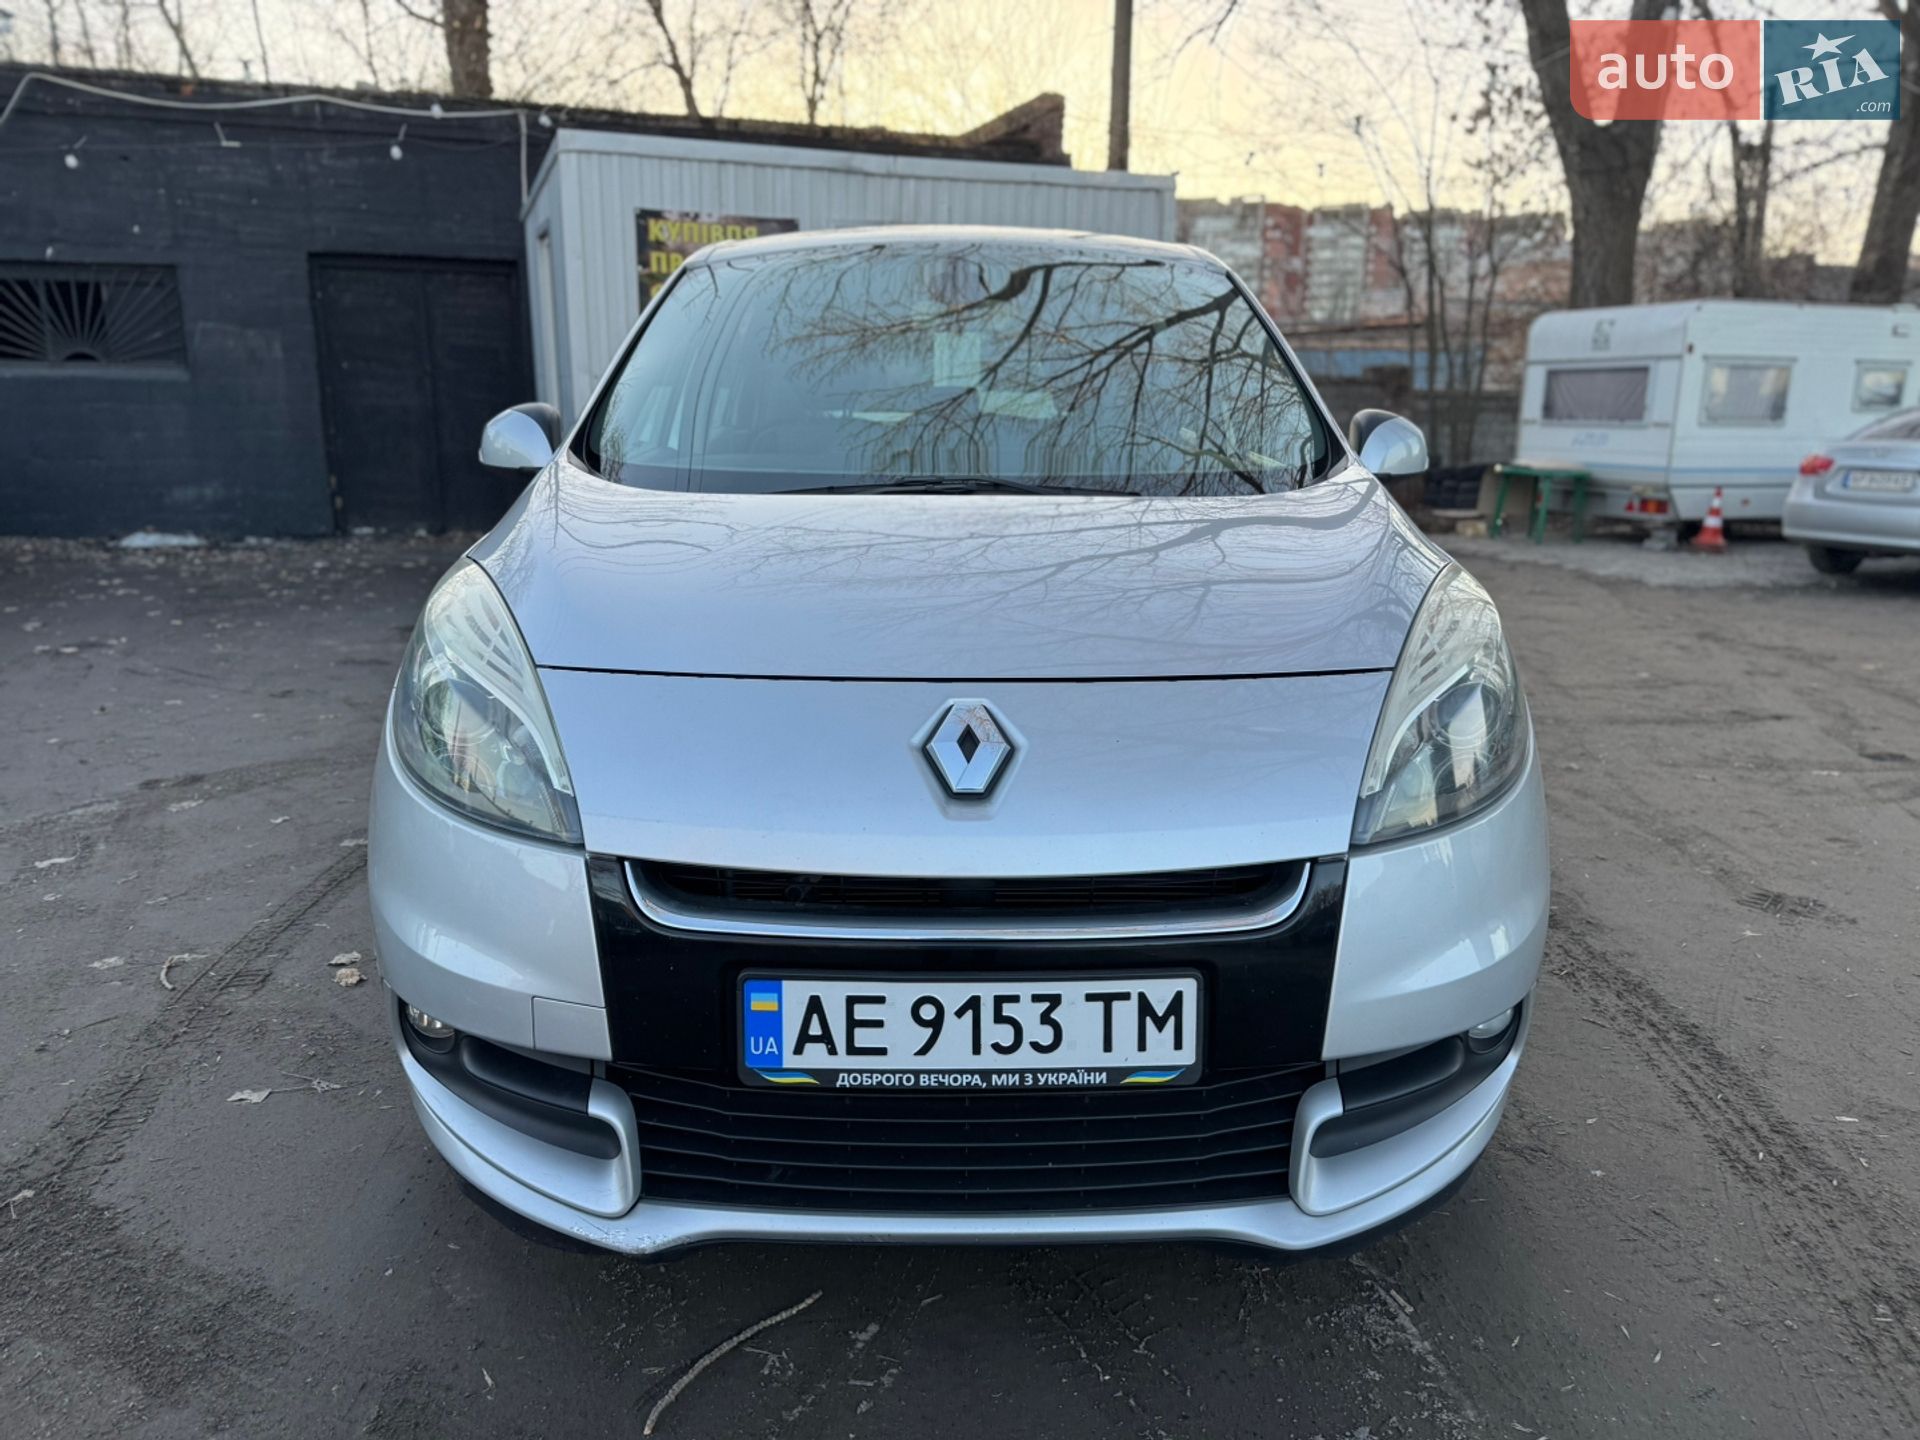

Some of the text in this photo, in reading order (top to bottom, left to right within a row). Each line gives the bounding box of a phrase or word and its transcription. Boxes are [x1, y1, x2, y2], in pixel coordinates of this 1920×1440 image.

[792, 989, 1184, 1056] AE 9153 TM
[750, 1036, 779, 1055] UA
[835, 1069, 1107, 1089] ДОБРОГО ВЕЧОРА, МИ З УКРАЇНИ
